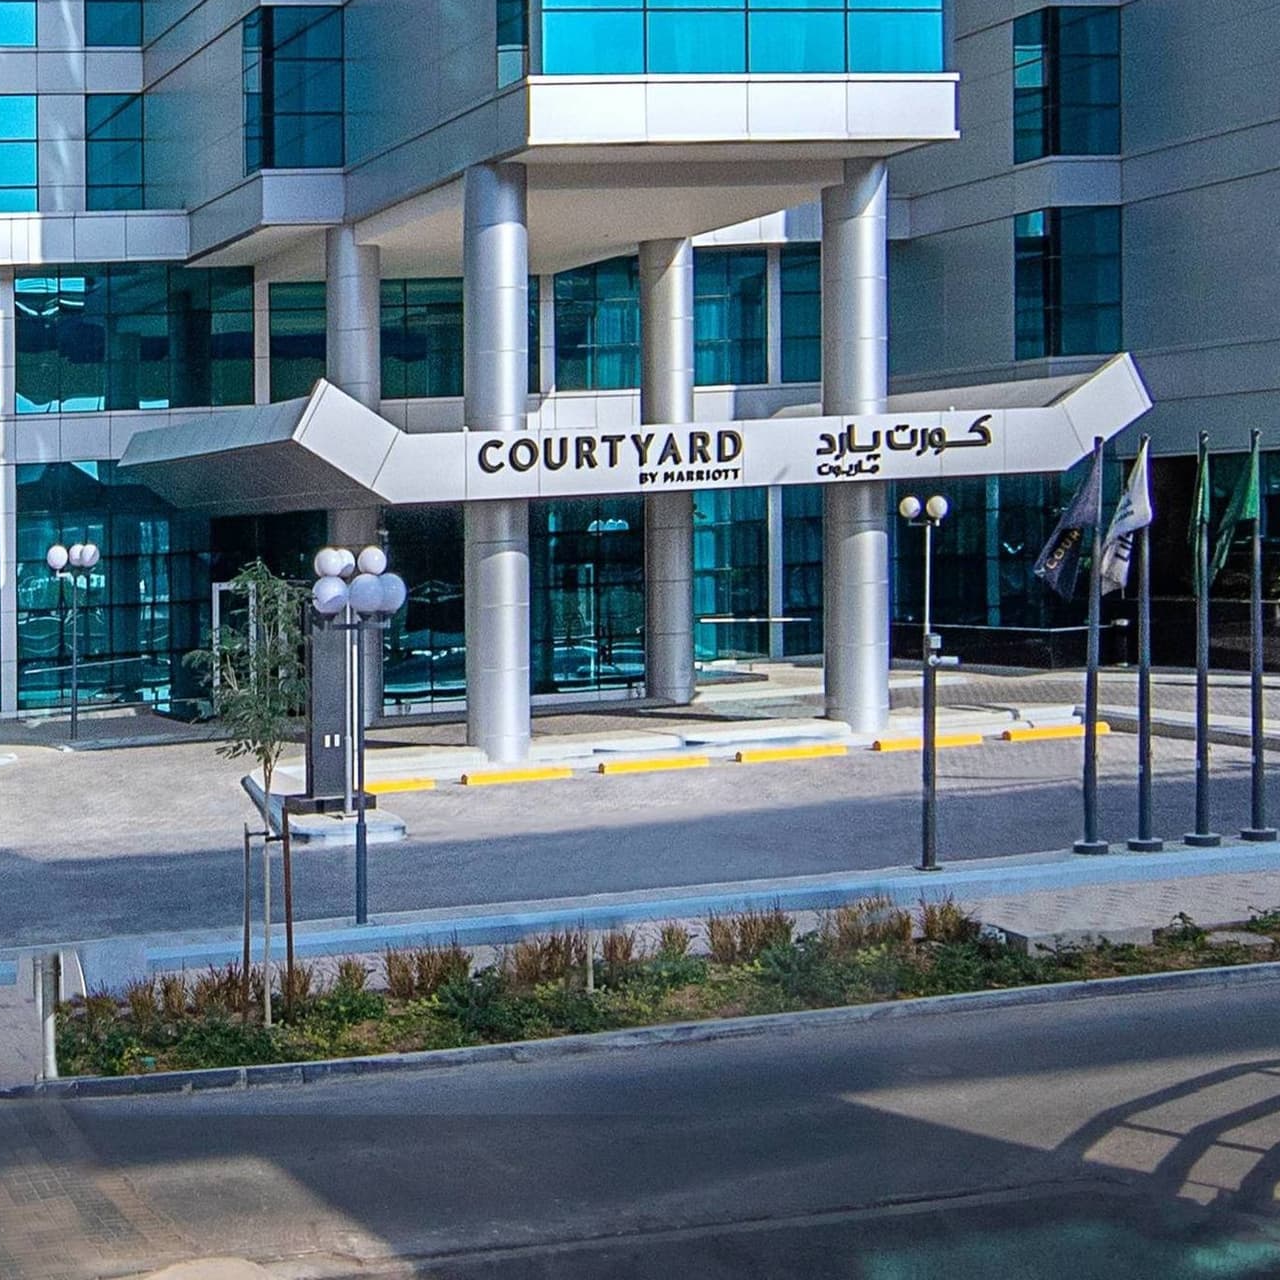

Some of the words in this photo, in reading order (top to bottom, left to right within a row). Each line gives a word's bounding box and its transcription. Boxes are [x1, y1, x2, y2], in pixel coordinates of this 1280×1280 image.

[477, 429, 743, 474] COURTYARD
[816, 424, 882, 461] يارد
[885, 414, 992, 456] كورت
[638, 472, 658, 485] BY
[662, 467, 741, 483] MARRIOTT
[816, 460, 880, 477] ماريوت
